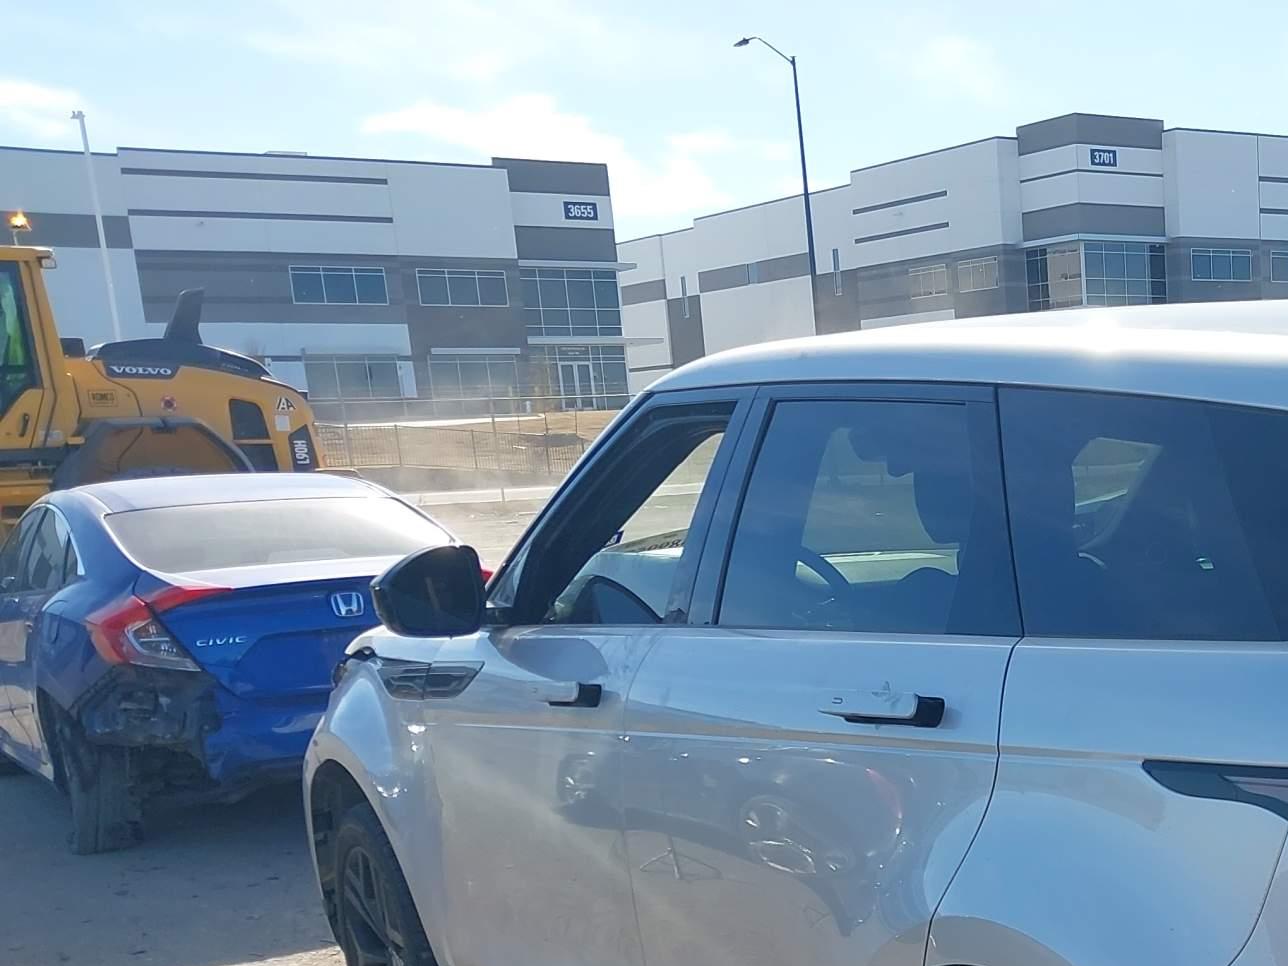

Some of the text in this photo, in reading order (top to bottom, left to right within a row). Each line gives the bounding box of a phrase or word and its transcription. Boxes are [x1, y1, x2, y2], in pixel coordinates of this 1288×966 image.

[1093, 151, 1114, 164] 3701
[567, 204, 594, 218] 3655
[110, 366, 172, 375] VOLVO
[293, 440, 310, 464] L90H
[196, 635, 248, 647] CIVIC
